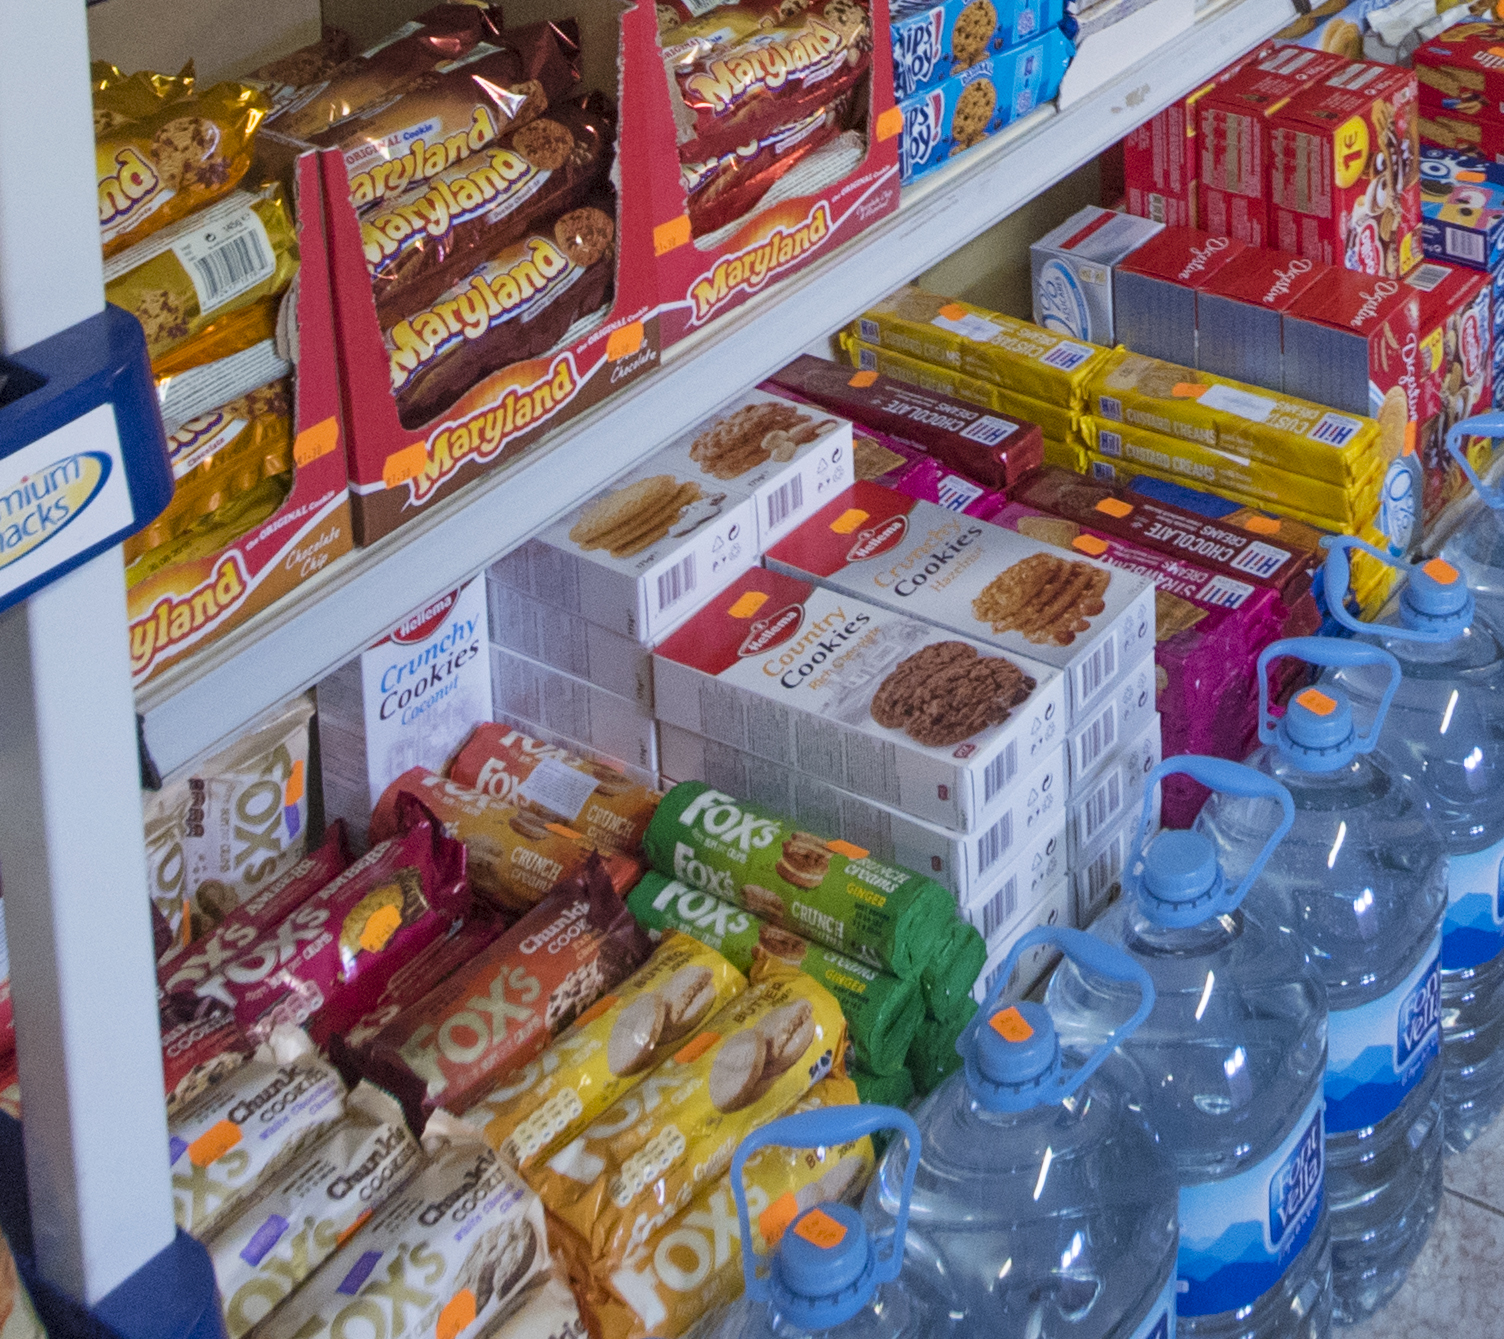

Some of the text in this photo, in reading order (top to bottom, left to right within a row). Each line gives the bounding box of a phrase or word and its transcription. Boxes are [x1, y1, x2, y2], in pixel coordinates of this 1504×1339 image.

[696, 201, 830, 321] Maryland
[389, 236, 569, 384] Maryland
[610, 349, 656, 384] Chocolate
[410, 350, 579, 505] Maryland
[285, 525, 342, 570] Chocolate
[853, 522, 903, 560] Hellema
[893, 523, 984, 599] Cookies
[1148, 521, 1233, 562] CHOCOLATE
[300, 552, 330, 579] Chip
[398, 594, 454, 638] Hellema
[749, 610, 799, 654] Hellema
[379, 618, 479, 696] Crunchy
[762, 605, 848, 680] Country
[779, 610, 870, 691] Cookies
[379, 638, 480, 722] Cookies
[400, 675, 460, 726] Coconut
[510, 845, 562, 877] CRUNCH
[846, 883, 887, 908] GINGER
[790, 901, 845, 938] CRUNCH
